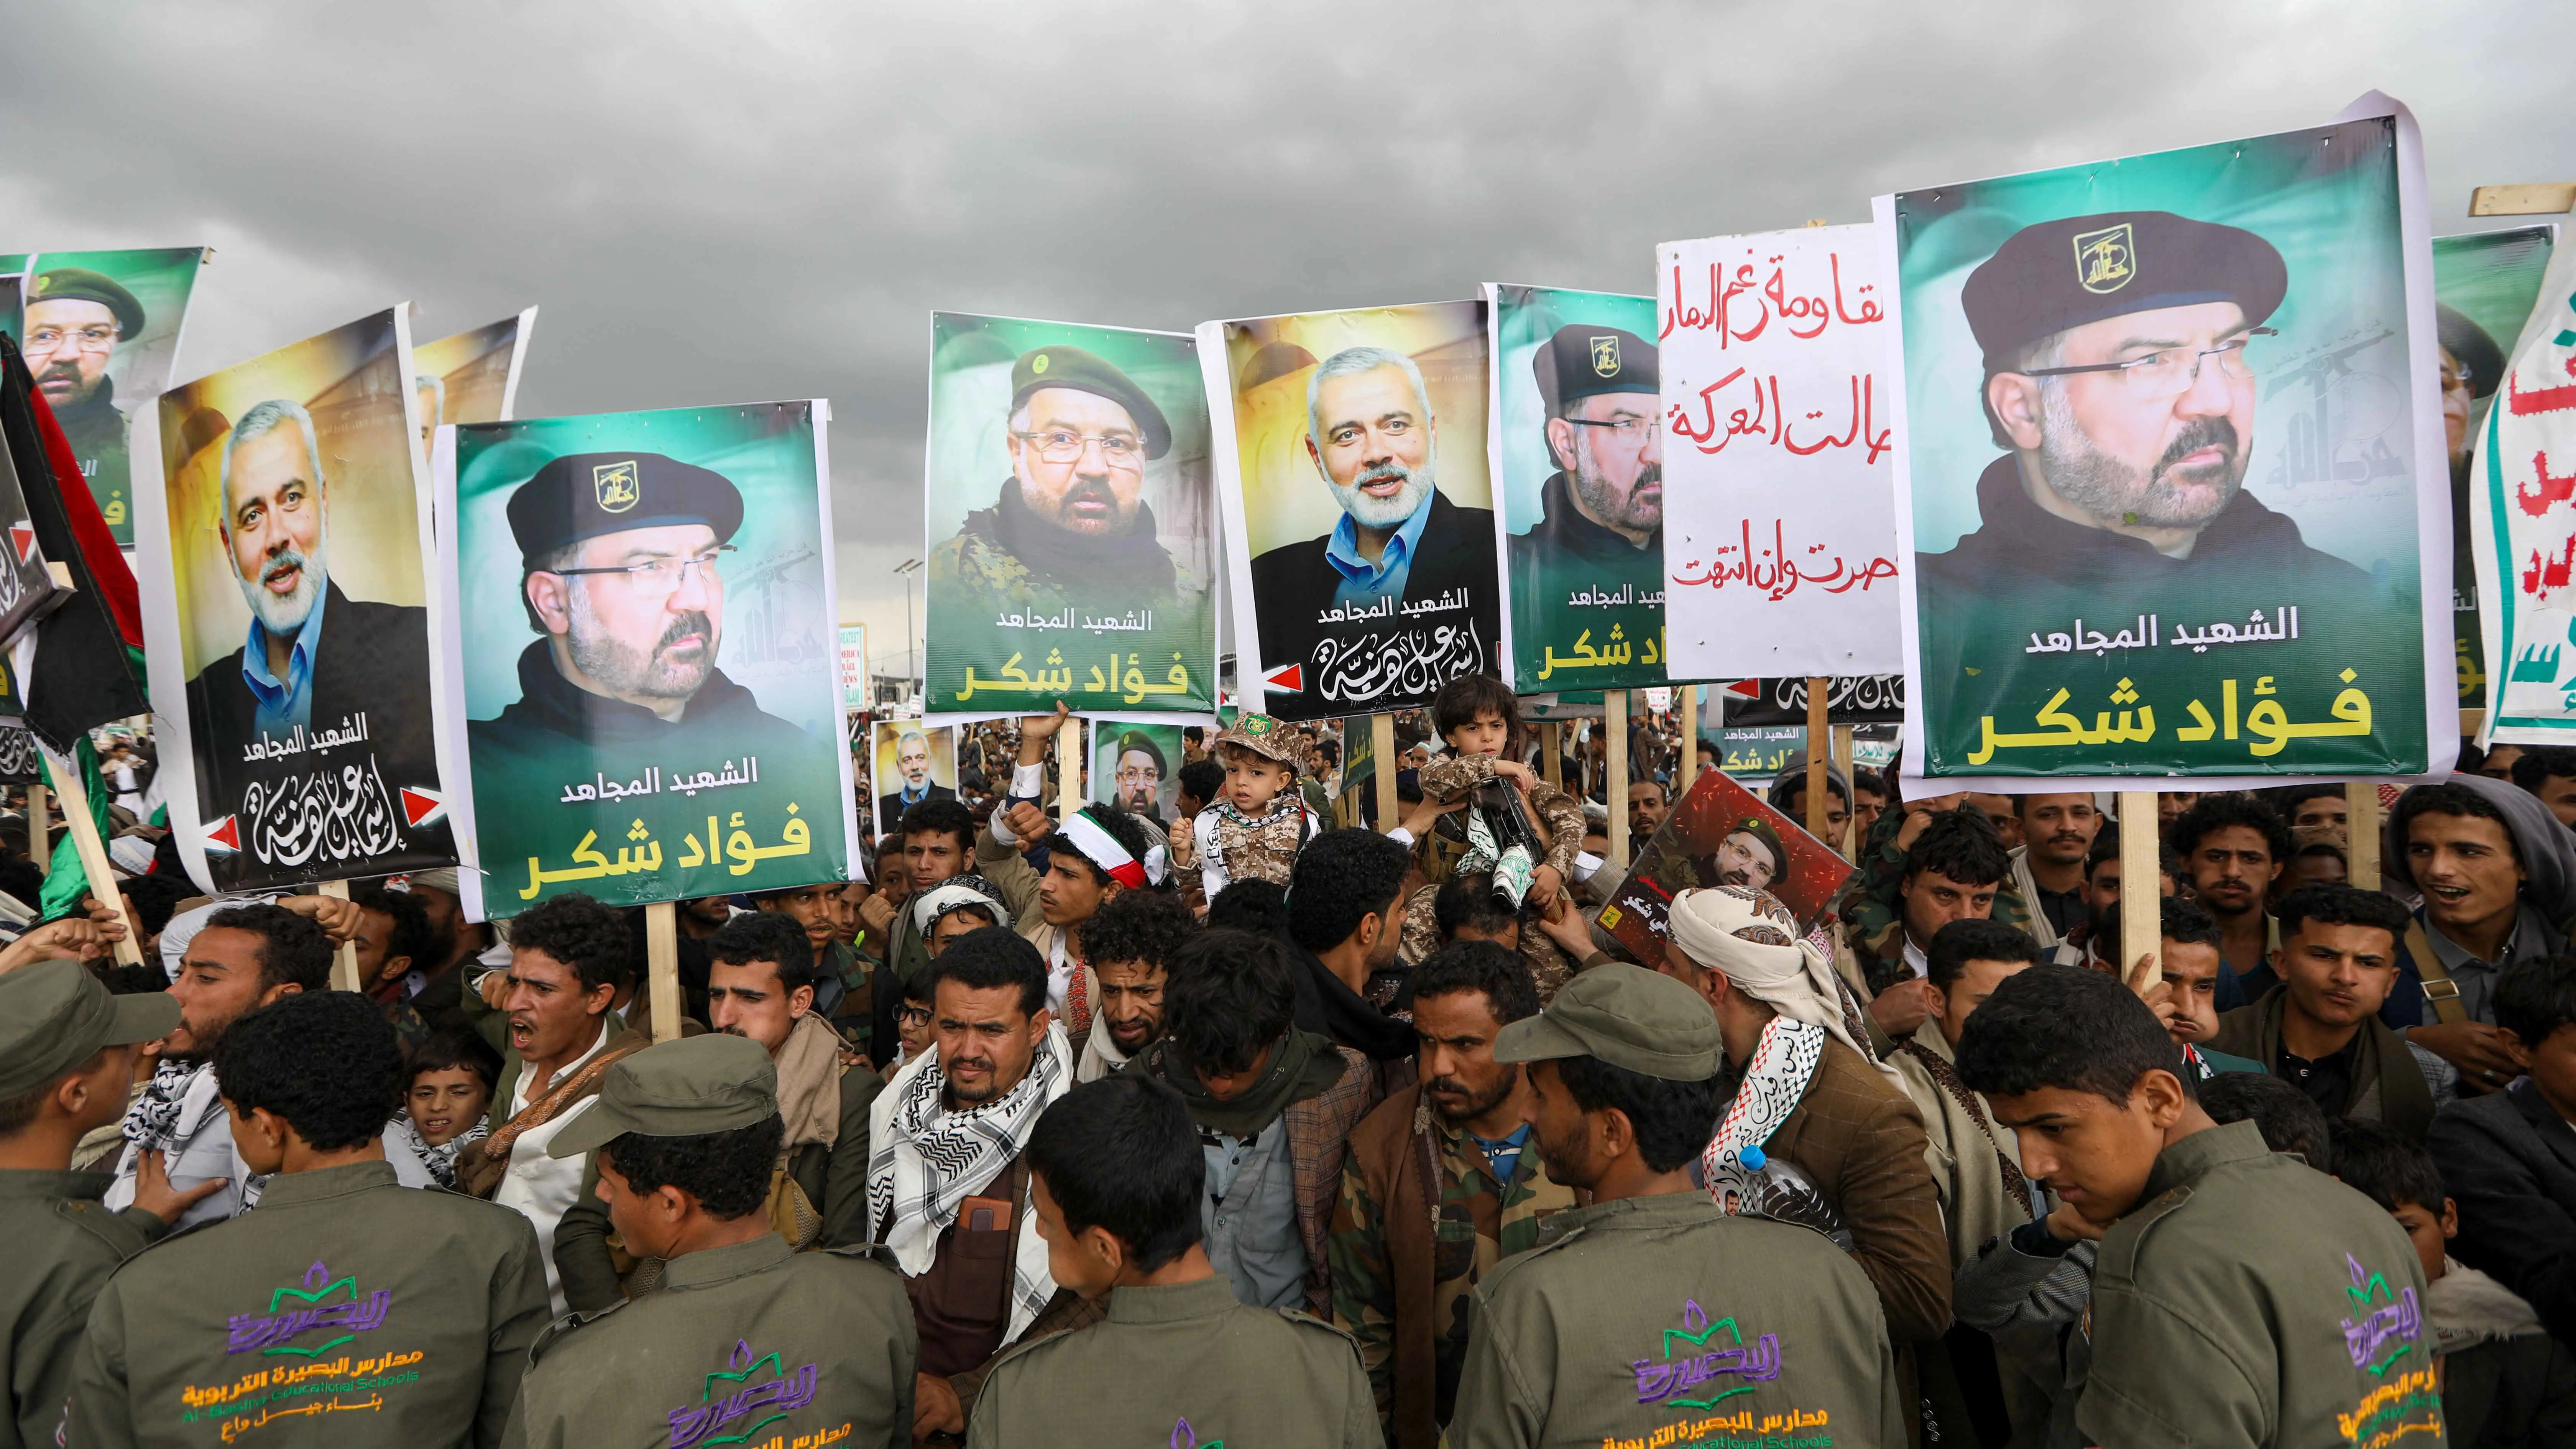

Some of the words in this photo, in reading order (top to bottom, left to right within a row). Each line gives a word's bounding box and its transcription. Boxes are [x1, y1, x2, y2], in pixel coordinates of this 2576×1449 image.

[1659, 263, 1722, 340] الدمار
[1722, 248, 1769, 350] رغم
[1765, 253, 1884, 338] قاومة
[1668, 367, 1782, 455] المعركة
[1755, 519, 1798, 601] وإن
[1318, 596, 1393, 625] المجاهد
[1401, 588, 1469, 616] الشهيد
[1569, 584, 1632, 609] المجاهد
[1638, 590, 1665, 609] هيد
[996, 607, 1074, 632] المجاهد
[1081, 610, 1152, 634] الشهيد
[2170, 606, 2298, 653] الشهيد
[840, 631, 859, 644] REATEST
[1641, 626, 1666, 664] اد
[2026, 614, 2157, 657] المجاهد
[841, 649, 859, 658] MERICA
[842, 662, 855, 671] RAEL
[1538, 623, 1631, 680] شكر
[956, 648, 1072, 701] شكر
[1084, 651, 1188, 704] فؤاد
[845, 688, 859, 702] SLAM
[1968, 676, 2156, 765] شكر
[2178, 667, 2372, 756] فؤاد
[243, 724, 306, 762] المجاهد
[310, 712, 368, 755] الشهيد
[1724, 728, 1761, 741] المجاهد
[1765, 728, 1799, 741] الشهيد
[1720, 748, 1762, 770] شك
[560, 767, 660, 803] المجاهد
[670, 756, 758, 797] الشهيد
[678, 802, 811, 876] فؤاد
[519, 818, 662, 900] شكر
[1623, 896, 1653, 918] شكر
[1649, 918, 1668, 933] لي
[272, 1357, 349, 1385] البصيرة
[350, 1350, 423, 1377] مدارس
[182, 1371, 268, 1407] التربوية
[272, 1380, 353, 1401] Educational
[357, 1371, 419, 1390] Schools
[792, 1423, 852, 1449] مدارس
[1678, 1411, 1753, 1441] البصيرة
[1758, 1408, 1829, 1434] مدارس
[1766, 1433, 1833, 1448] Schools
